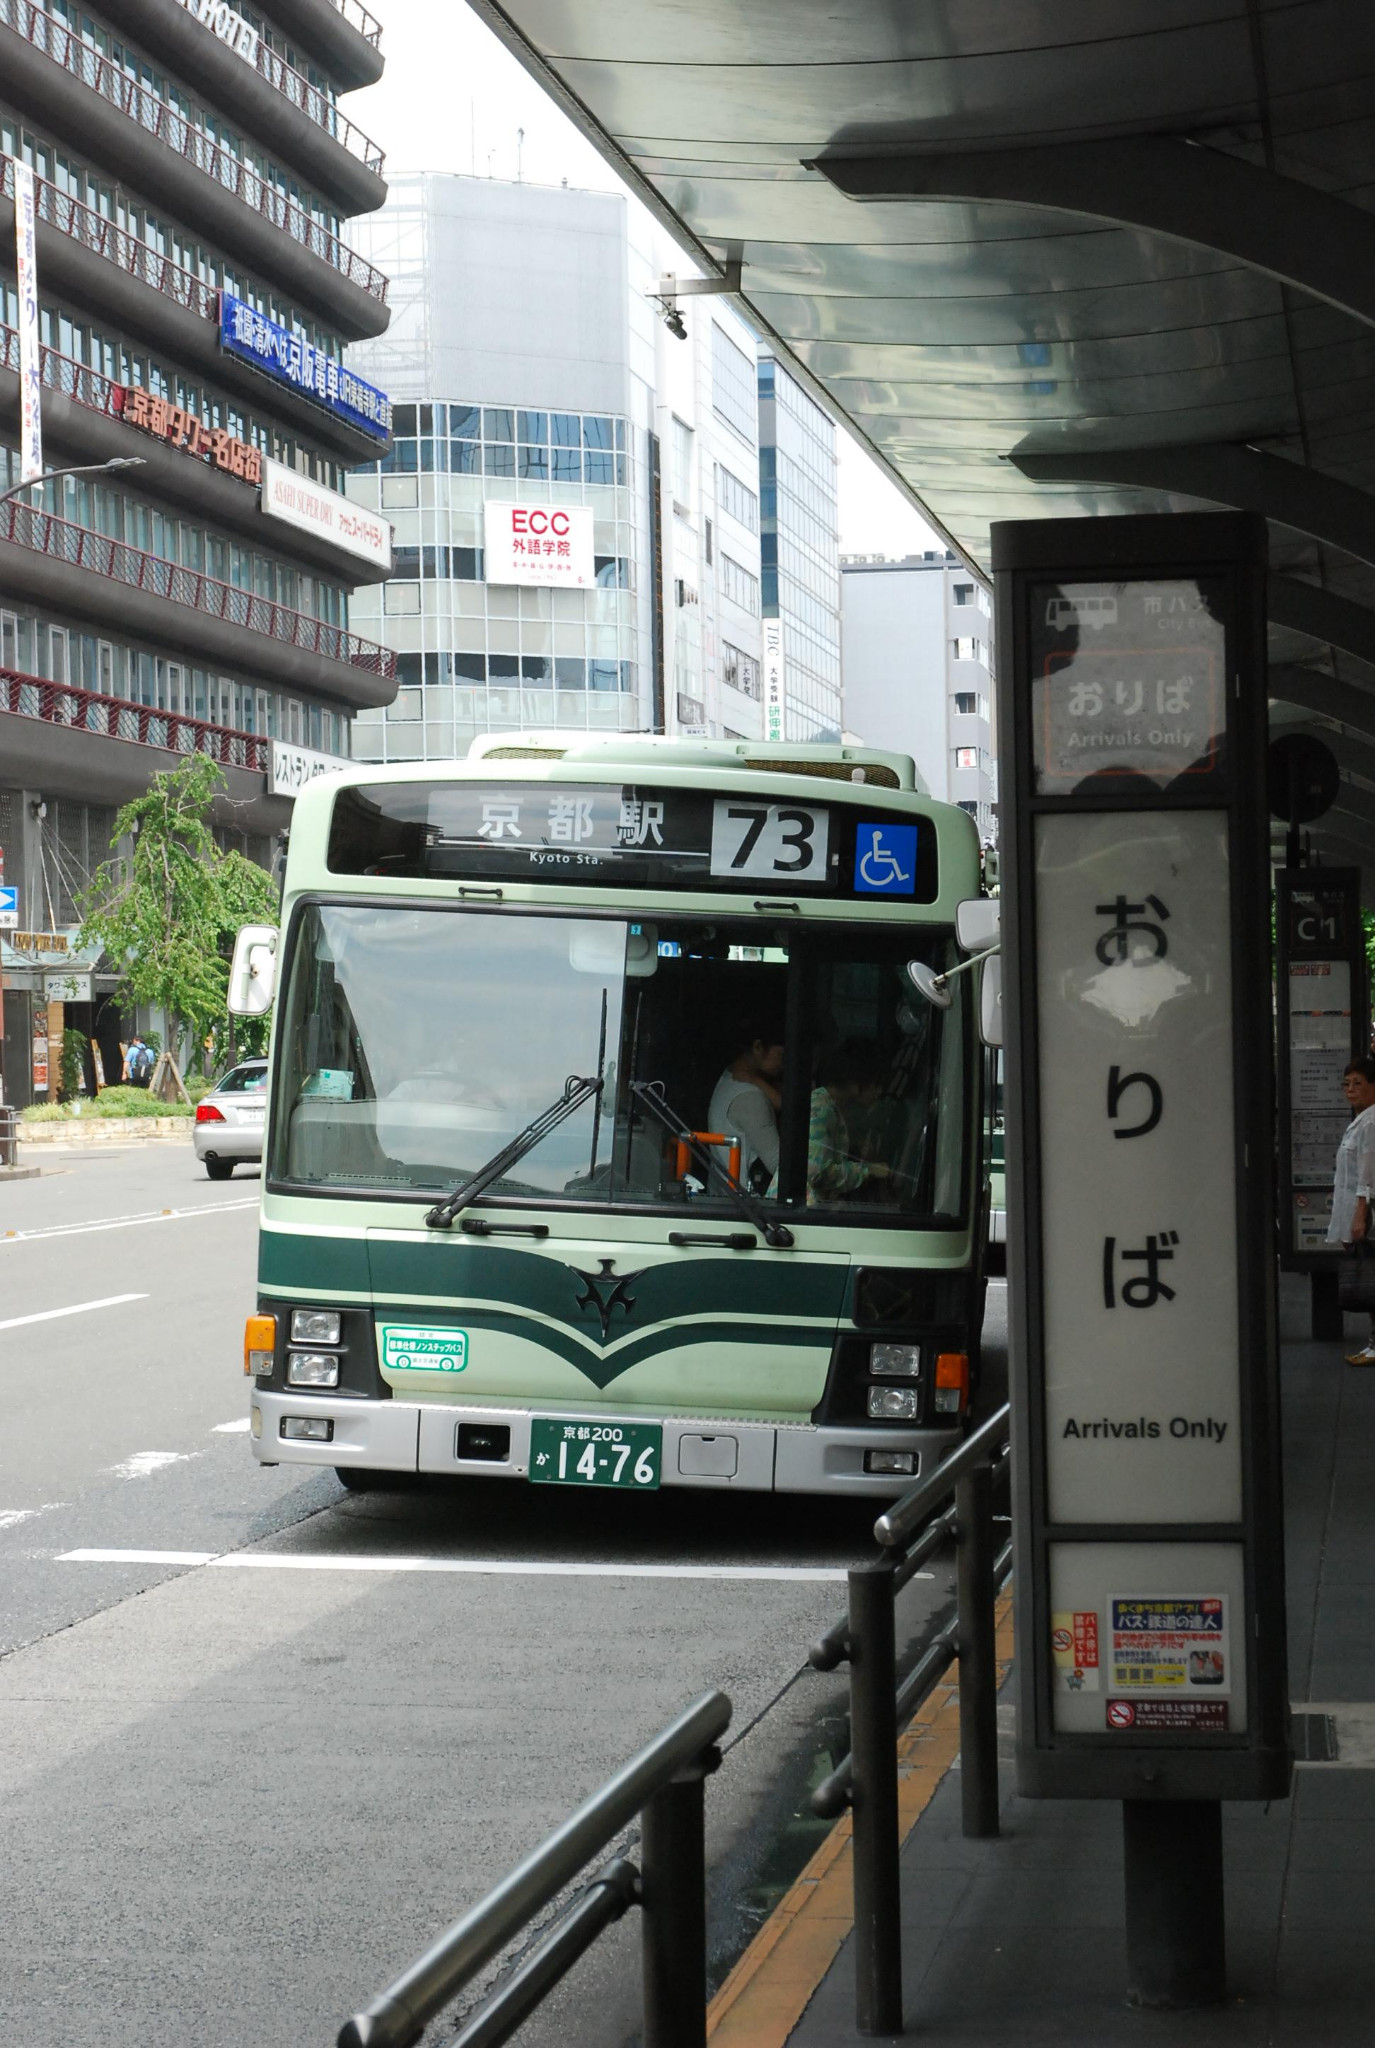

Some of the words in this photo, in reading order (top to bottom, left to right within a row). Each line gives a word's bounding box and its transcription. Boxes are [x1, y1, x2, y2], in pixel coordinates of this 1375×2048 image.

[198, 0, 259, 69] HOTEL
[123, 386, 262, 484] 京都タワー名店街
[273, 480, 296, 509] ASAHI
[297, 489, 319, 521] SUPER
[320, 501, 334, 527] DRY
[512, 509, 570, 536] ECC
[513, 538, 571, 557] 外語学院
[1068, 676, 1194, 717] おりば
[1068, 730, 1142, 748] Arrivals
[1149, 729, 1194, 748] Only
[476, 795, 665, 847] 京都駅
[727, 807, 816, 872] 73
[529, 851, 571, 866] Kyoto
[576, 852, 604, 866] Sta.
[1297, 917, 1336, 940] C1
[1095, 894, 1181, 1310] おりば
[389, 1340, 462, 1353] 標準仕様ノンステップバス
[1062, 1417, 1161, 1440] Arrivals
[1169, 1416, 1229, 1444] Only
[536, 1451, 550, 1466] か
[558, 1441, 655, 1484] 14-76
